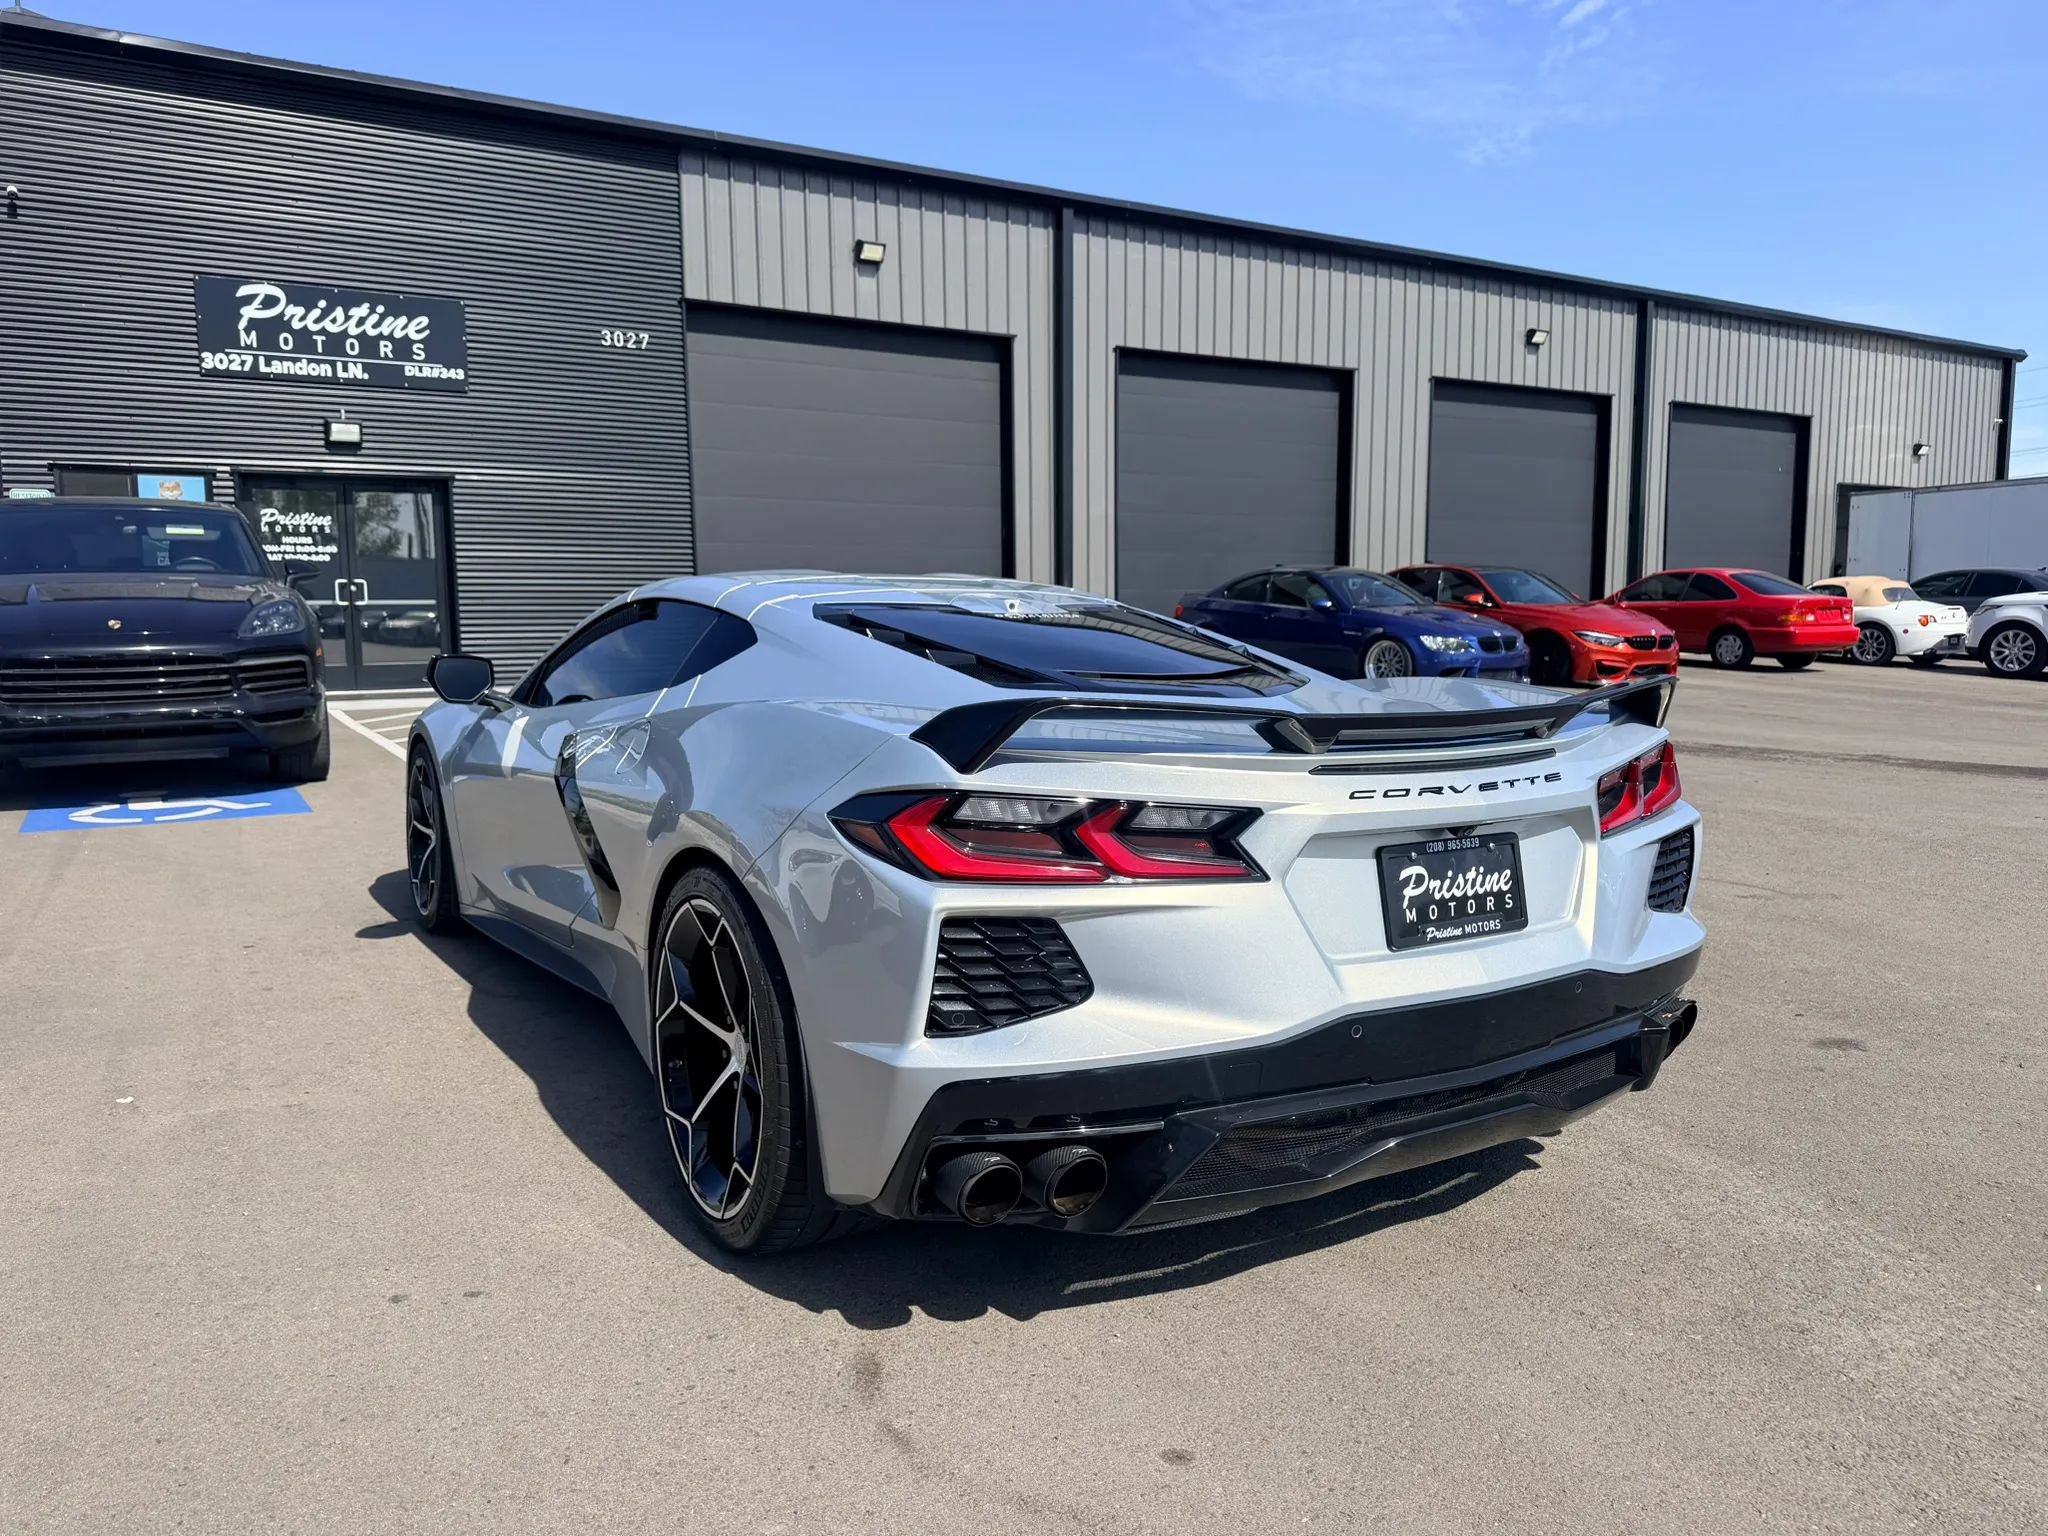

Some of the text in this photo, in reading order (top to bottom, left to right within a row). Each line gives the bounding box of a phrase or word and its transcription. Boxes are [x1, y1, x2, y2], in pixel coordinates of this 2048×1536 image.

[235, 283, 430, 341] Pristine
[239, 329, 426, 360] MOTORS
[601, 329, 649, 349] 3027
[200, 352, 369, 380] 3027 Landon LN.
[260, 507, 332, 526] Pristine
[261, 525, 331, 533] MOTORS
[282, 536, 313, 544] HOURS
[262, 545, 295, 553] ON-FRI
[1348, 772, 1562, 800] CORVETTE
[1426, 837, 1480, 853] (208) 965-5639
[1399, 865, 1512, 909] Pristine
[1405, 893, 1514, 924] MOTORS
[1426, 919, 1501, 941] Pristine MOTORS
